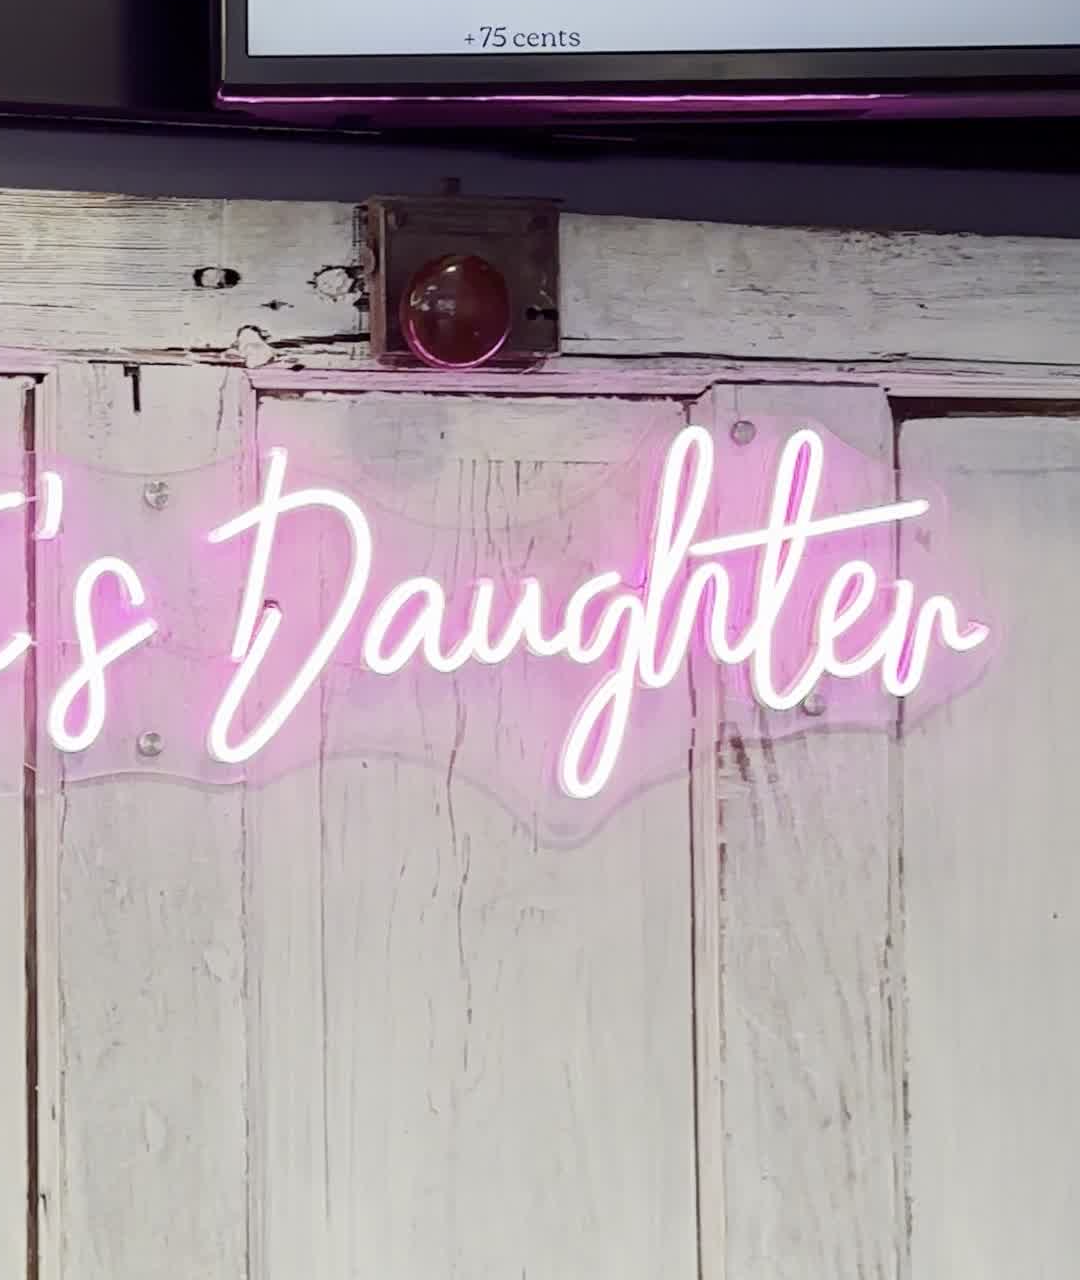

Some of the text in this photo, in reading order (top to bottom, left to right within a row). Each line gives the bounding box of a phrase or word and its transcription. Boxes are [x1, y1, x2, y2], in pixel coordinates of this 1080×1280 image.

[464, 26, 581, 49] +75 cents
[206, 423, 990, 800] Daughter
